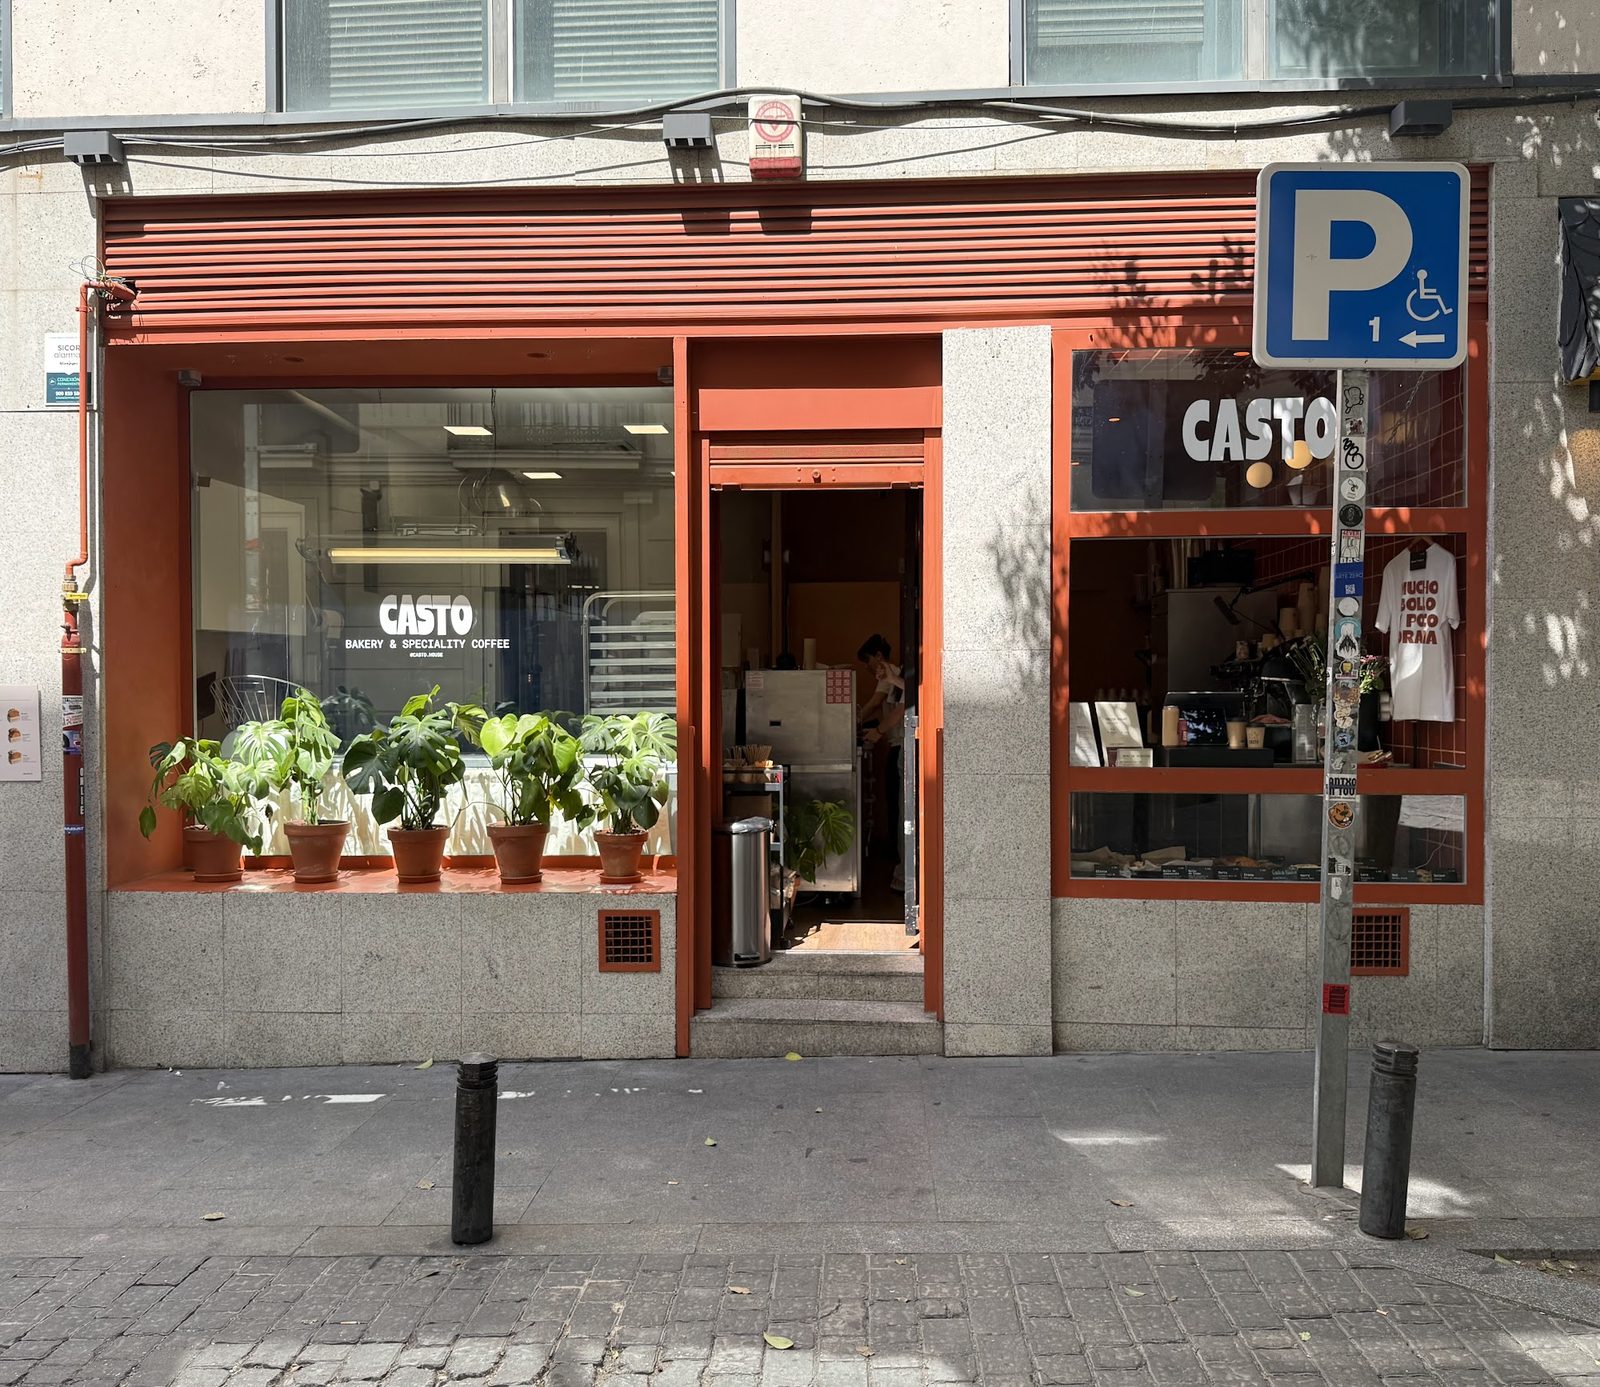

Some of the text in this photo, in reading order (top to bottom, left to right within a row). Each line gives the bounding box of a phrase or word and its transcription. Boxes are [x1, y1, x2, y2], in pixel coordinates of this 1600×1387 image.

[1292, 189, 1413, 341] P
[1368, 316, 1381, 342] 1
[1182, 396, 1338, 462] CASTO
[379, 594, 473, 636] CASTO
[345, 639, 510, 649] BAKERY & SPECIALITY COFFEE
